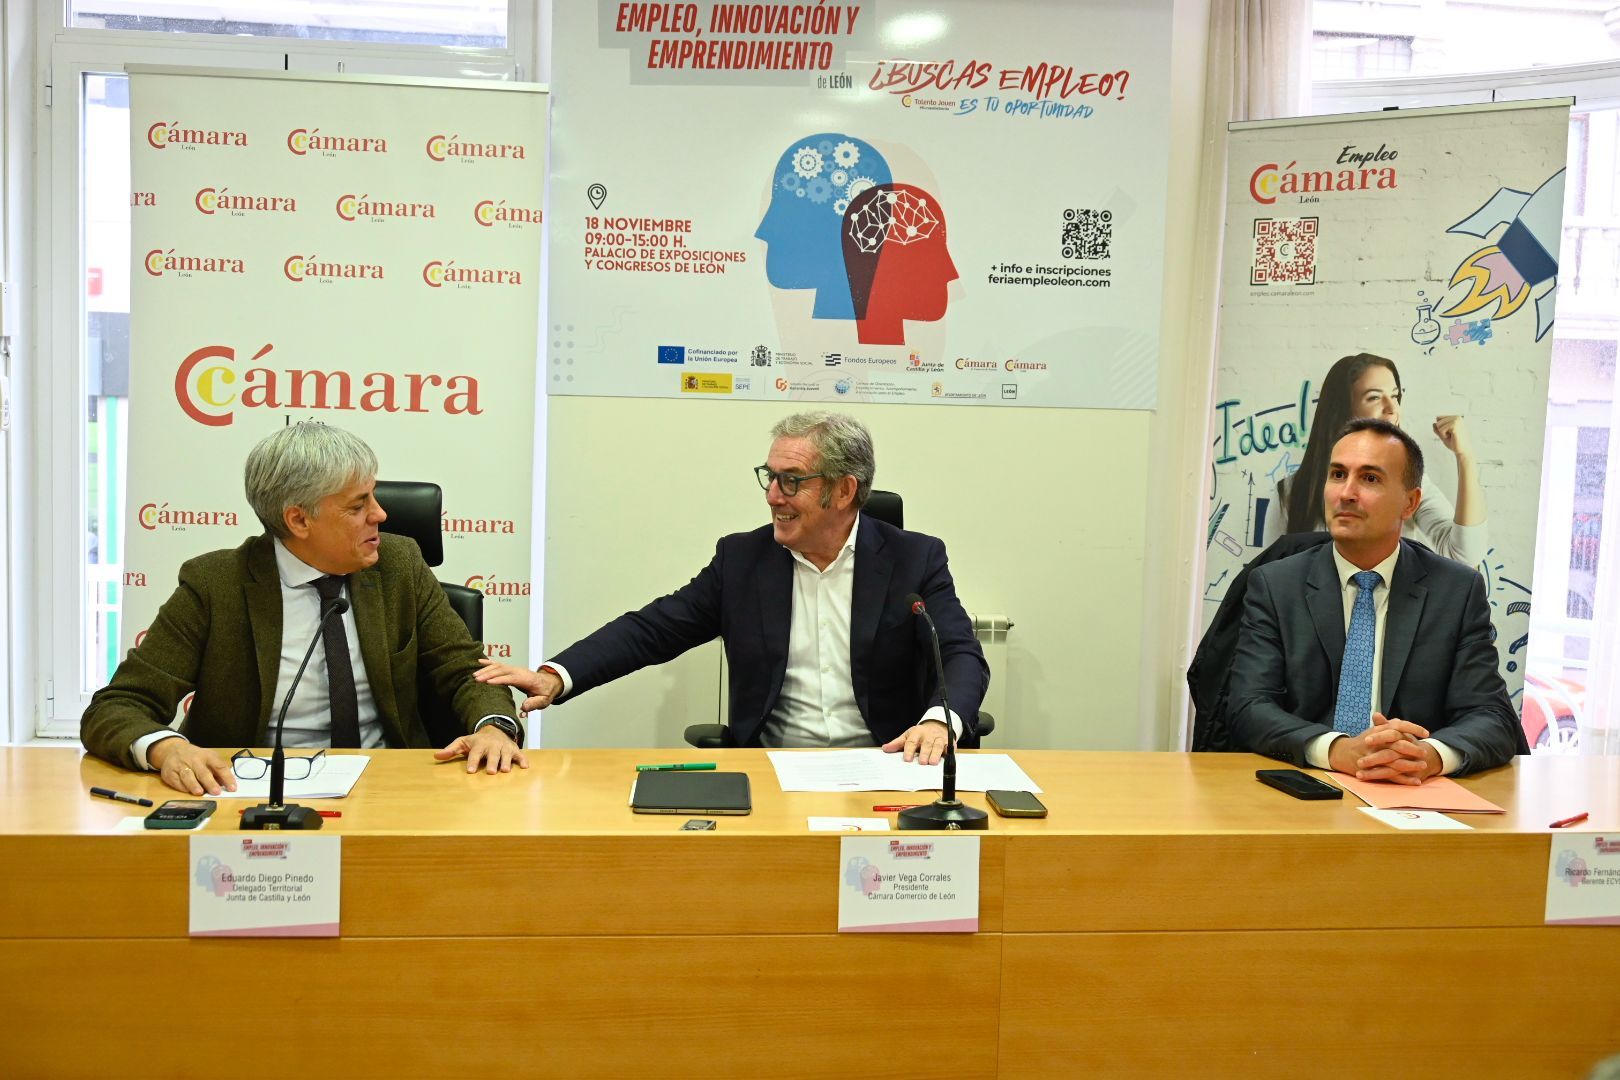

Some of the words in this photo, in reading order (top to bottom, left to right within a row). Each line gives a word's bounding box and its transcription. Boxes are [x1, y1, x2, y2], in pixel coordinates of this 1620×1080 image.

[615, 2, 702, 37] EMPLEO,
[709, 0, 842, 35] INNOVACIÓN
[846, 6, 861, 35] Y
[647, 39, 833, 71] EMPRENDIMIENTO
[817, 76, 827, 89] de
[829, 73, 853, 89] LEÓN
[868, 59, 993, 95] ¿BUSCAS
[998, 62, 1131, 101] EMPLEO?
[914, 98, 937, 106] Talento
[953, 98, 979, 116] ES
[1004, 99, 1095, 120] OPORTUNIDAD
[147, 121, 248, 149] Cámara
[287, 128, 388, 155] Cámara
[426, 134, 526, 162] Cámara
[1336, 143, 1399, 169] Empleo
[1249, 160, 1398, 205] Cámara
[195, 187, 297, 215] Cámara
[335, 194, 437, 221] Cámara
[1299, 195, 1320, 204] León
[584, 216, 599, 230] 18
[604, 217, 692, 233] NOVIEMBRE
[585, 232, 669, 248] 09:00-15:00
[673, 235, 687, 248] H.
[144, 248, 246, 277] Cámara
[584, 247, 637, 259] PALACIO
[640, 249, 656, 260] DE
[659, 249, 747, 263] EXPOSICIONES
[283, 254, 385, 283] Cámara
[422, 260, 522, 288] Cámara
[584, 260, 593, 270] Y
[596, 260, 671, 273] CONGRESOS
[674, 262, 690, 273] DE
[693, 259, 725, 274] LEÓN
[1000, 263, 1023, 274] info
[1025, 266, 1033, 274] e
[1035, 264, 1112, 277] inscripciones
[988, 273, 1111, 288] feriaempleoleon.com
[687, 348, 727, 356] Cofinanciado
[687, 355, 693, 363] la
[713, 356, 738, 364] Europea
[868, 357, 897, 365] Europeos
[955, 358, 998, 370] Cámara
[1005, 359, 1047, 372] Cámara
[174, 342, 484, 428] Cámara
[1215, 380, 1311, 465] Idea!
[138, 502, 239, 530] Cámara
[221, 873, 256, 882] Eduardo
[258, 873, 282, 884] Diego
[285, 873, 314, 883] Pinedo
[873, 873, 896, 882] Javier
[898, 874, 917, 884] Vega
[919, 873, 952, 882] Corrales
[232, 884, 266, 893] Delegado
[269, 884, 303, 892] Territorial
[893, 883, 929, 891] Presidente
[226, 894, 246, 902] Junta
[868, 892, 894, 900] Cámara
[895, 892, 928, 900] Comercio
[929, 892, 938, 900] de
[939, 892, 956, 900] León
